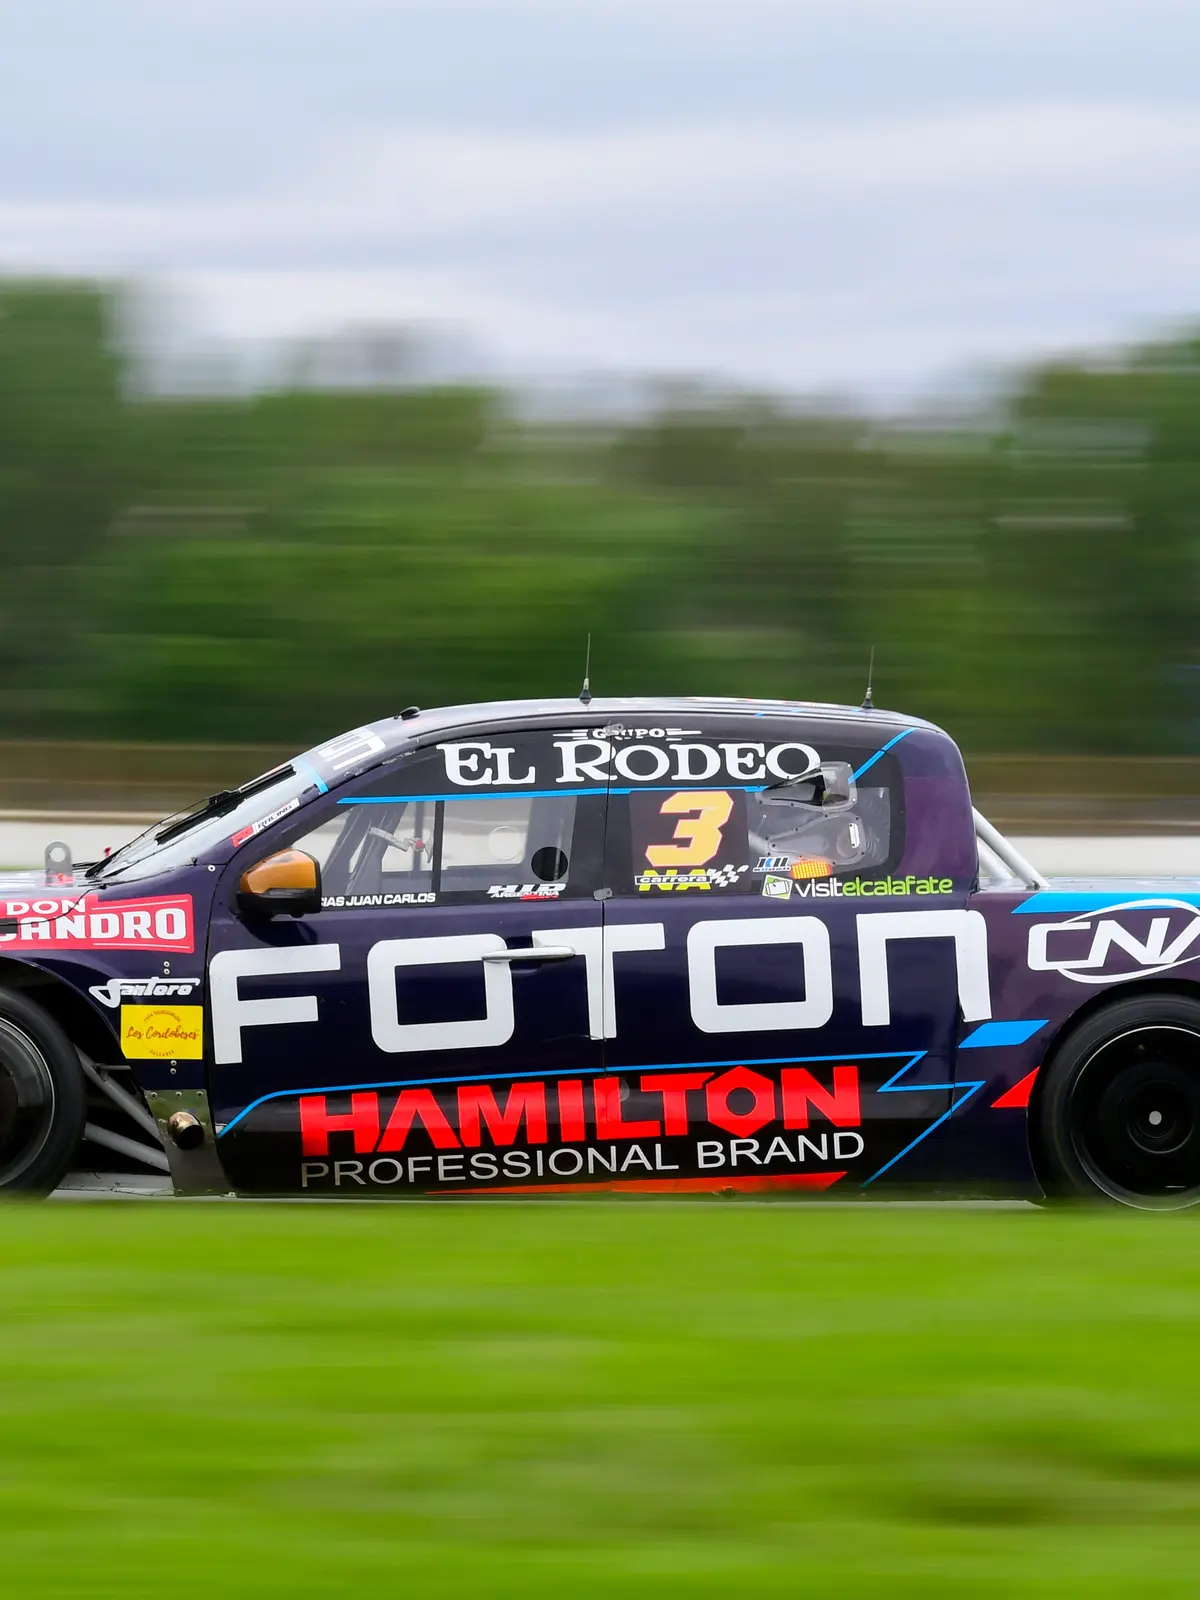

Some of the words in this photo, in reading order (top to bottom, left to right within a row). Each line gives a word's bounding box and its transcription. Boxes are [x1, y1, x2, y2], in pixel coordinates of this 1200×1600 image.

[436, 742, 536, 786] EL
[553, 740, 822, 783] RODEO
[645, 791, 734, 867] 3
[638, 876, 709, 884] carrera
[794, 875, 953, 898] visitelcalafate
[6, 898, 87, 916] DON
[346, 895, 382, 906] JUAN
[383, 893, 436, 904] CARLOS
[0, 907, 188, 943] ANDRO
[89, 976, 200, 1008] Santoro
[126, 1026, 143, 1039] Los
[146, 1025, 199, 1040] Cordobeses
[299, 1065, 861, 1157] HAMILTON
[301, 1142, 679, 1188] PROFESSIONAL
[696, 1131, 865, 1169] BRAND
